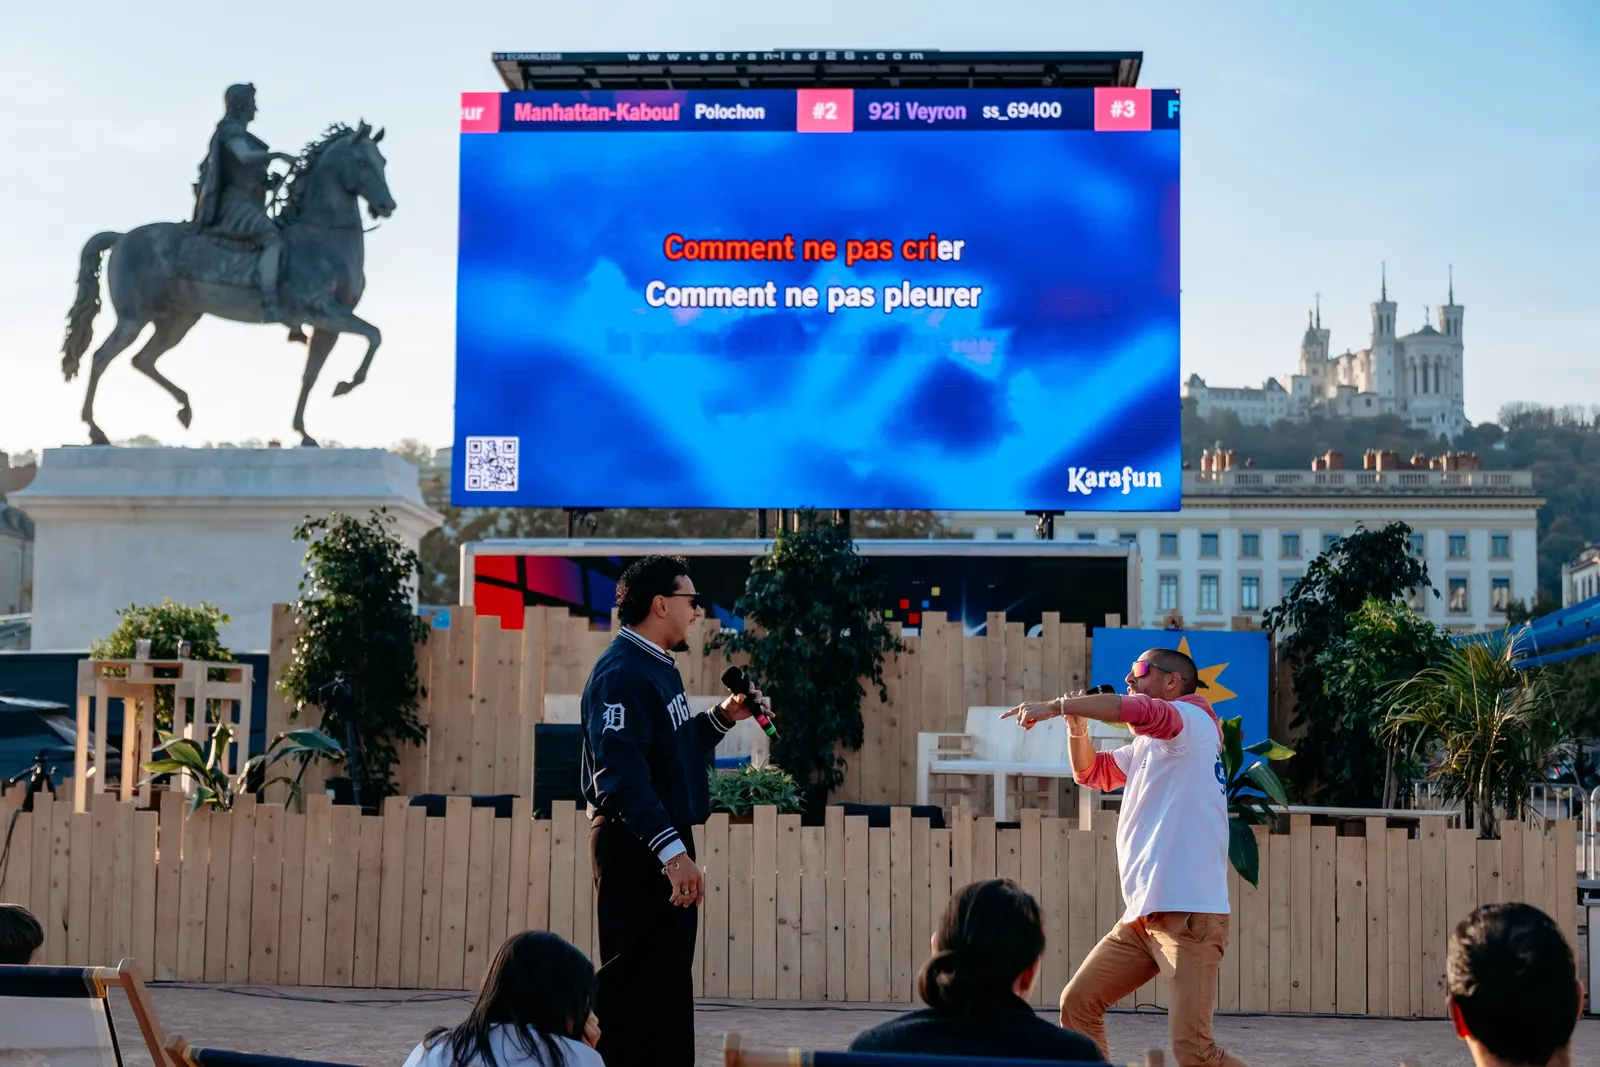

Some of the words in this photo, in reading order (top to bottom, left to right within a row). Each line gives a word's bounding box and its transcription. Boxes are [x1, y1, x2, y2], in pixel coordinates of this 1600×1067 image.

[514, 102, 680, 121] Manhattan-Kaboul
[695, 104, 765, 120] Polochon
[812, 102, 838, 120] #2
[868, 102, 900, 120] 92i
[906, 102, 967, 124] Veyron
[982, 102, 1062, 120] ss_69400
[1110, 101, 1136, 118] #3
[1168, 100, 1180, 118] F
[664, 234, 795, 261] Comment
[804, 240, 837, 260] ne
[846, 240, 894, 266] pas
[902, 234, 965, 260] crier
[645, 280, 777, 307] Comment
[785, 287, 820, 307] ne
[827, 287, 875, 313] pas
[884, 281, 982, 313] pleurer
[1067, 466, 1163, 496] Karafun
